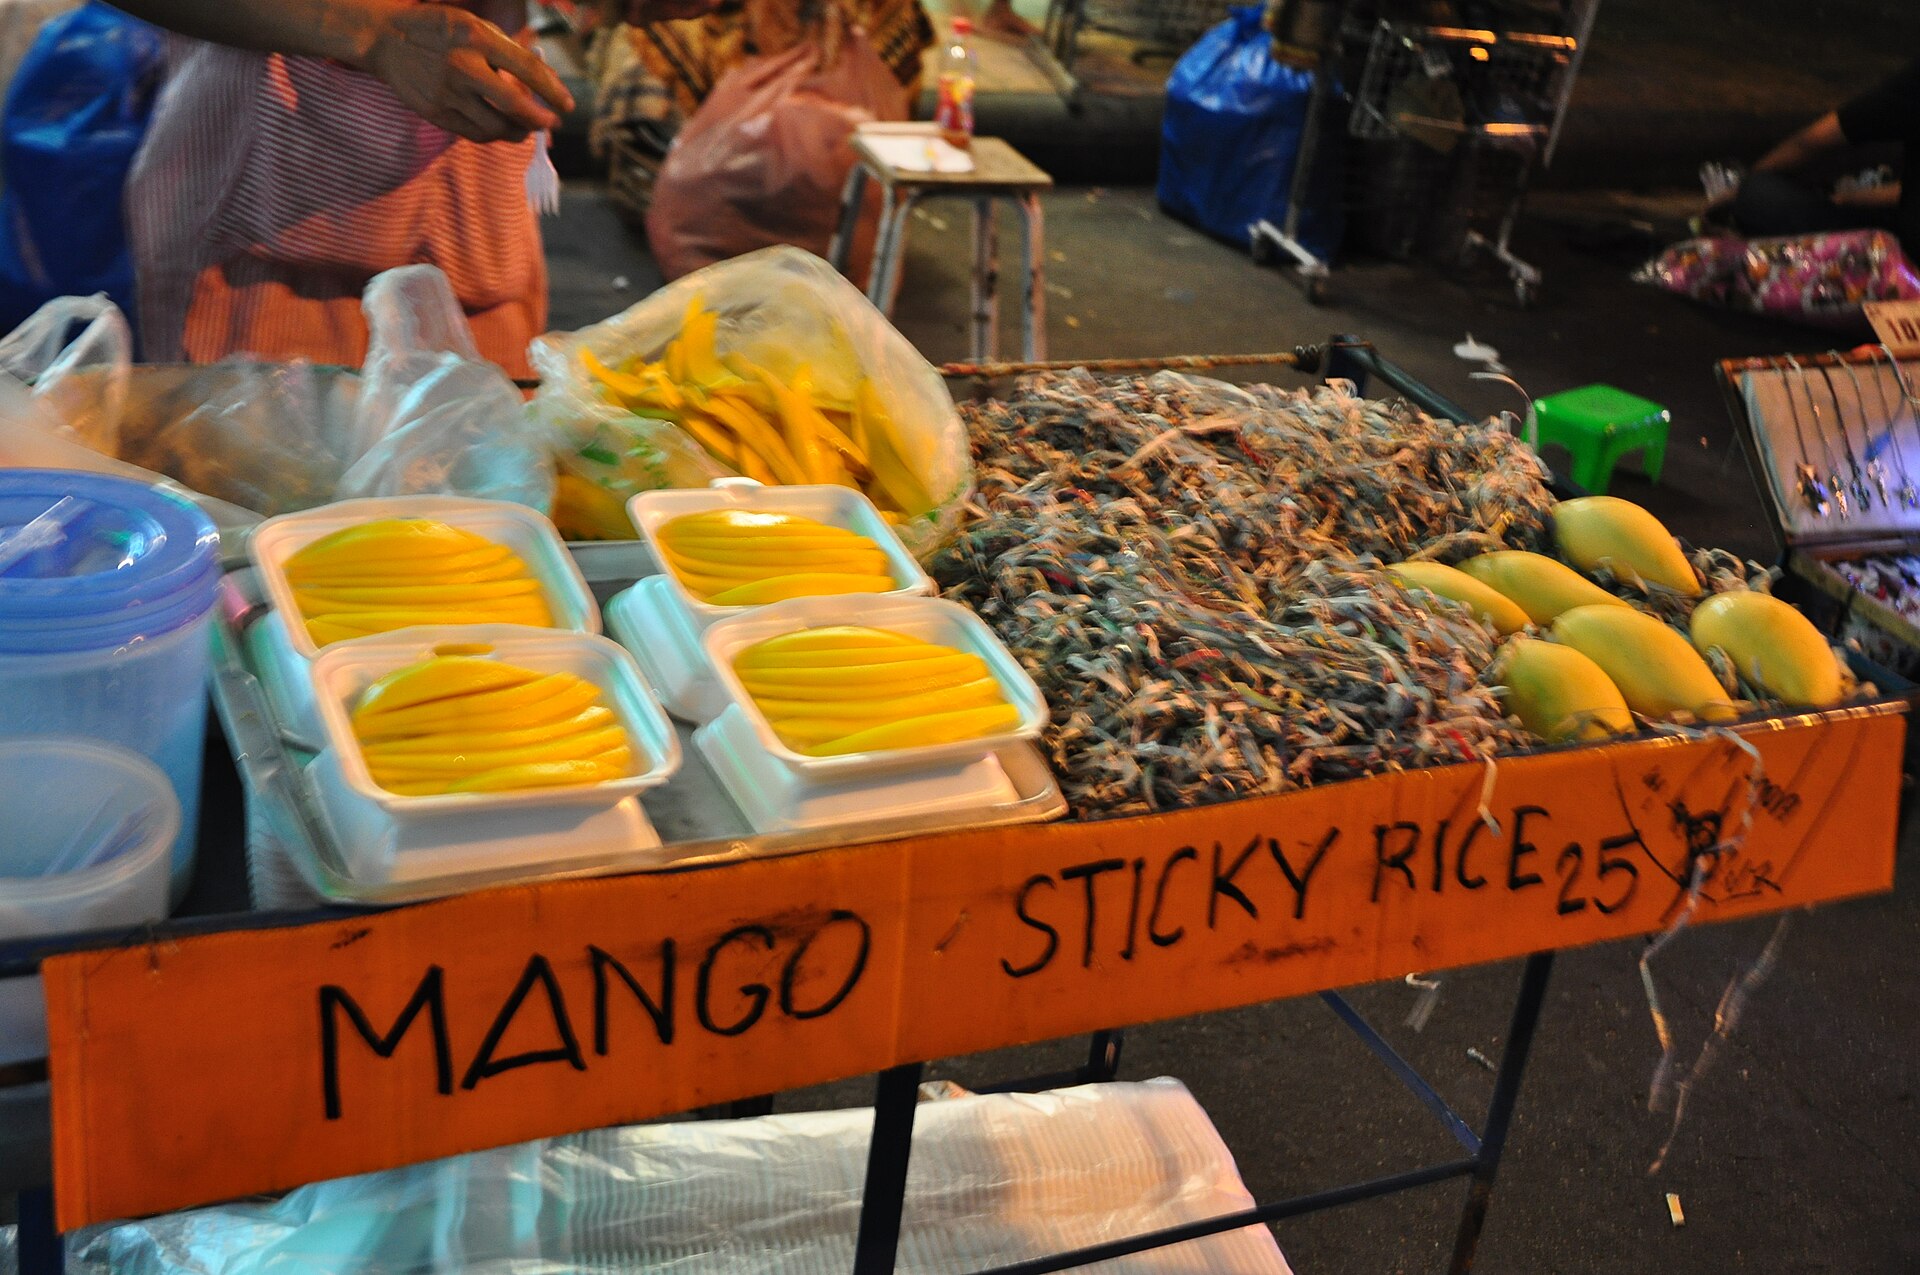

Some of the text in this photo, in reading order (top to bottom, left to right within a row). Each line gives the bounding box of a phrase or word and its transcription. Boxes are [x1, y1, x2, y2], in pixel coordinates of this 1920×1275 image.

[1886, 318, 1920, 342] 10
[318, 909, 871, 1121] MANGO
[1000, 826, 1340, 977] STICKY
[1370, 805, 1551, 902] RICE
[1556, 830, 1640, 914] 25
